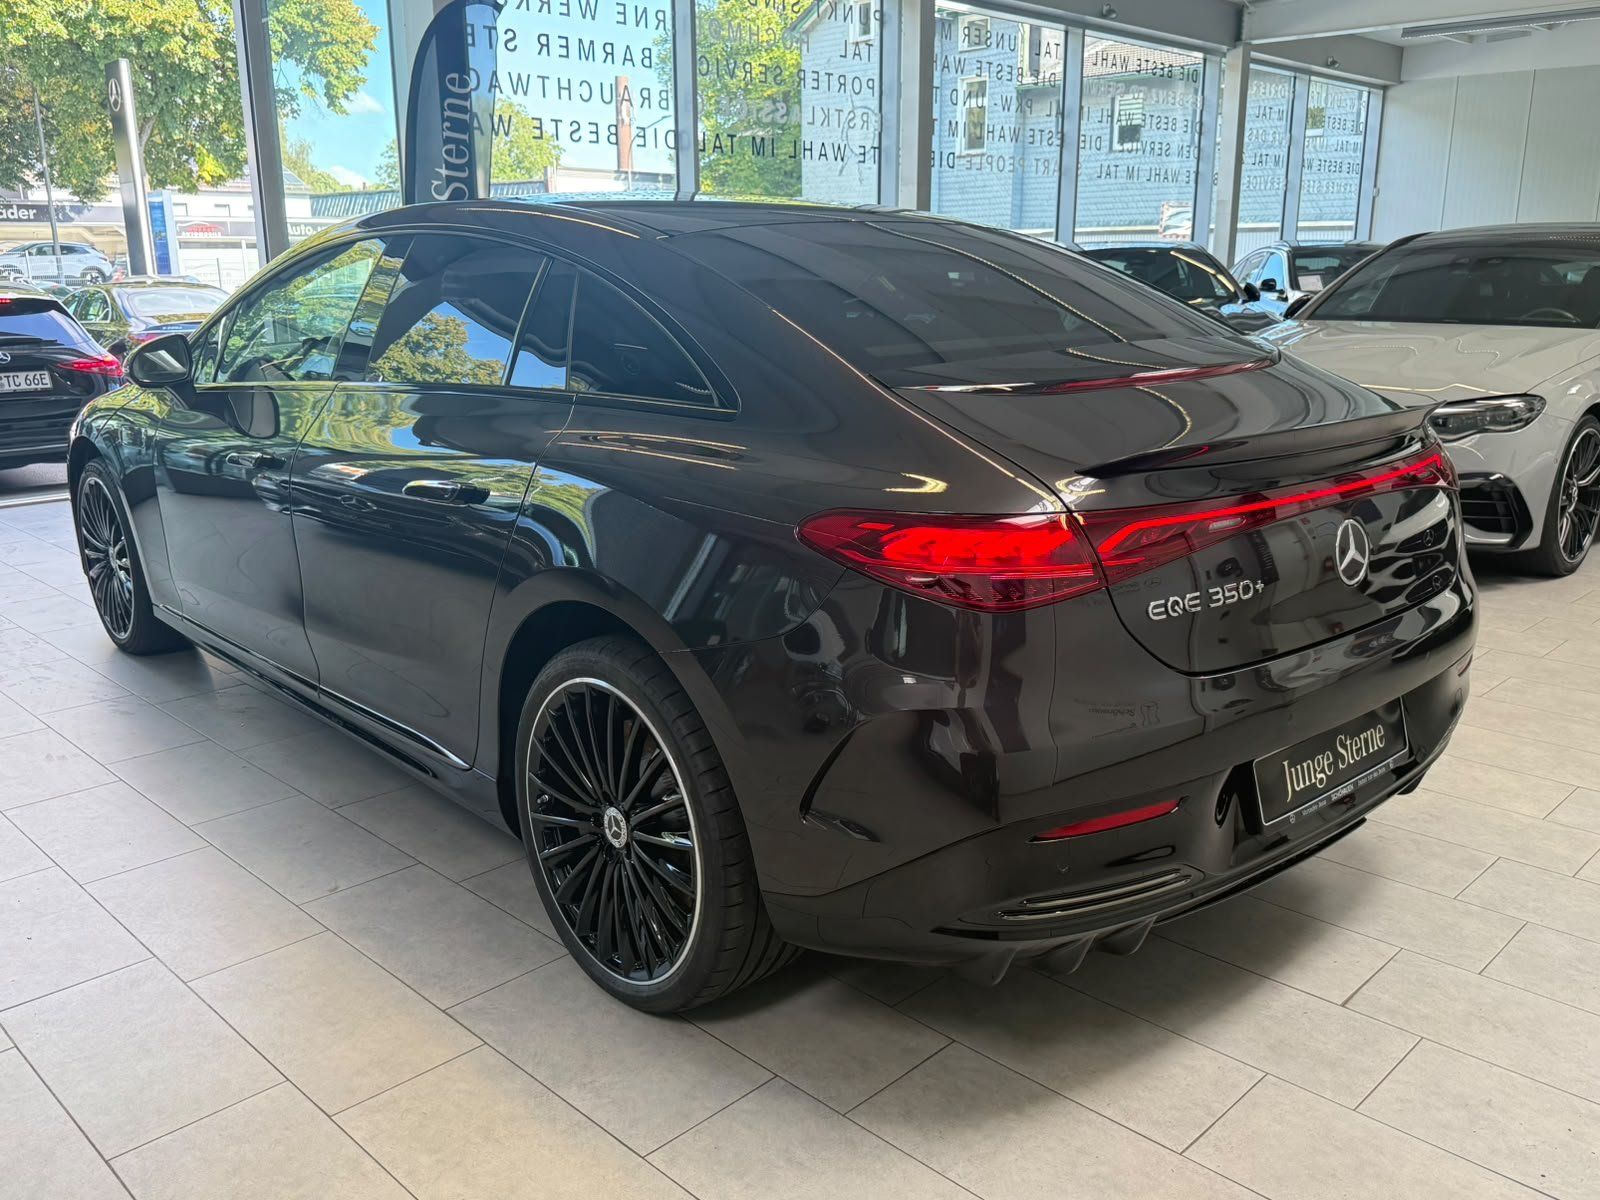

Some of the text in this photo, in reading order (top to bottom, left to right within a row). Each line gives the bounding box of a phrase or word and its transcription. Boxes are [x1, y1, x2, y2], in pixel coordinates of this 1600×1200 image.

[431, 71, 471, 200] Sterne
[24, 373, 49, 387] 66E
[1147, 579, 1265, 621] EQE 350+
[1281, 751, 1335, 802] Junge
[1336, 724, 1386, 770] Sterne
